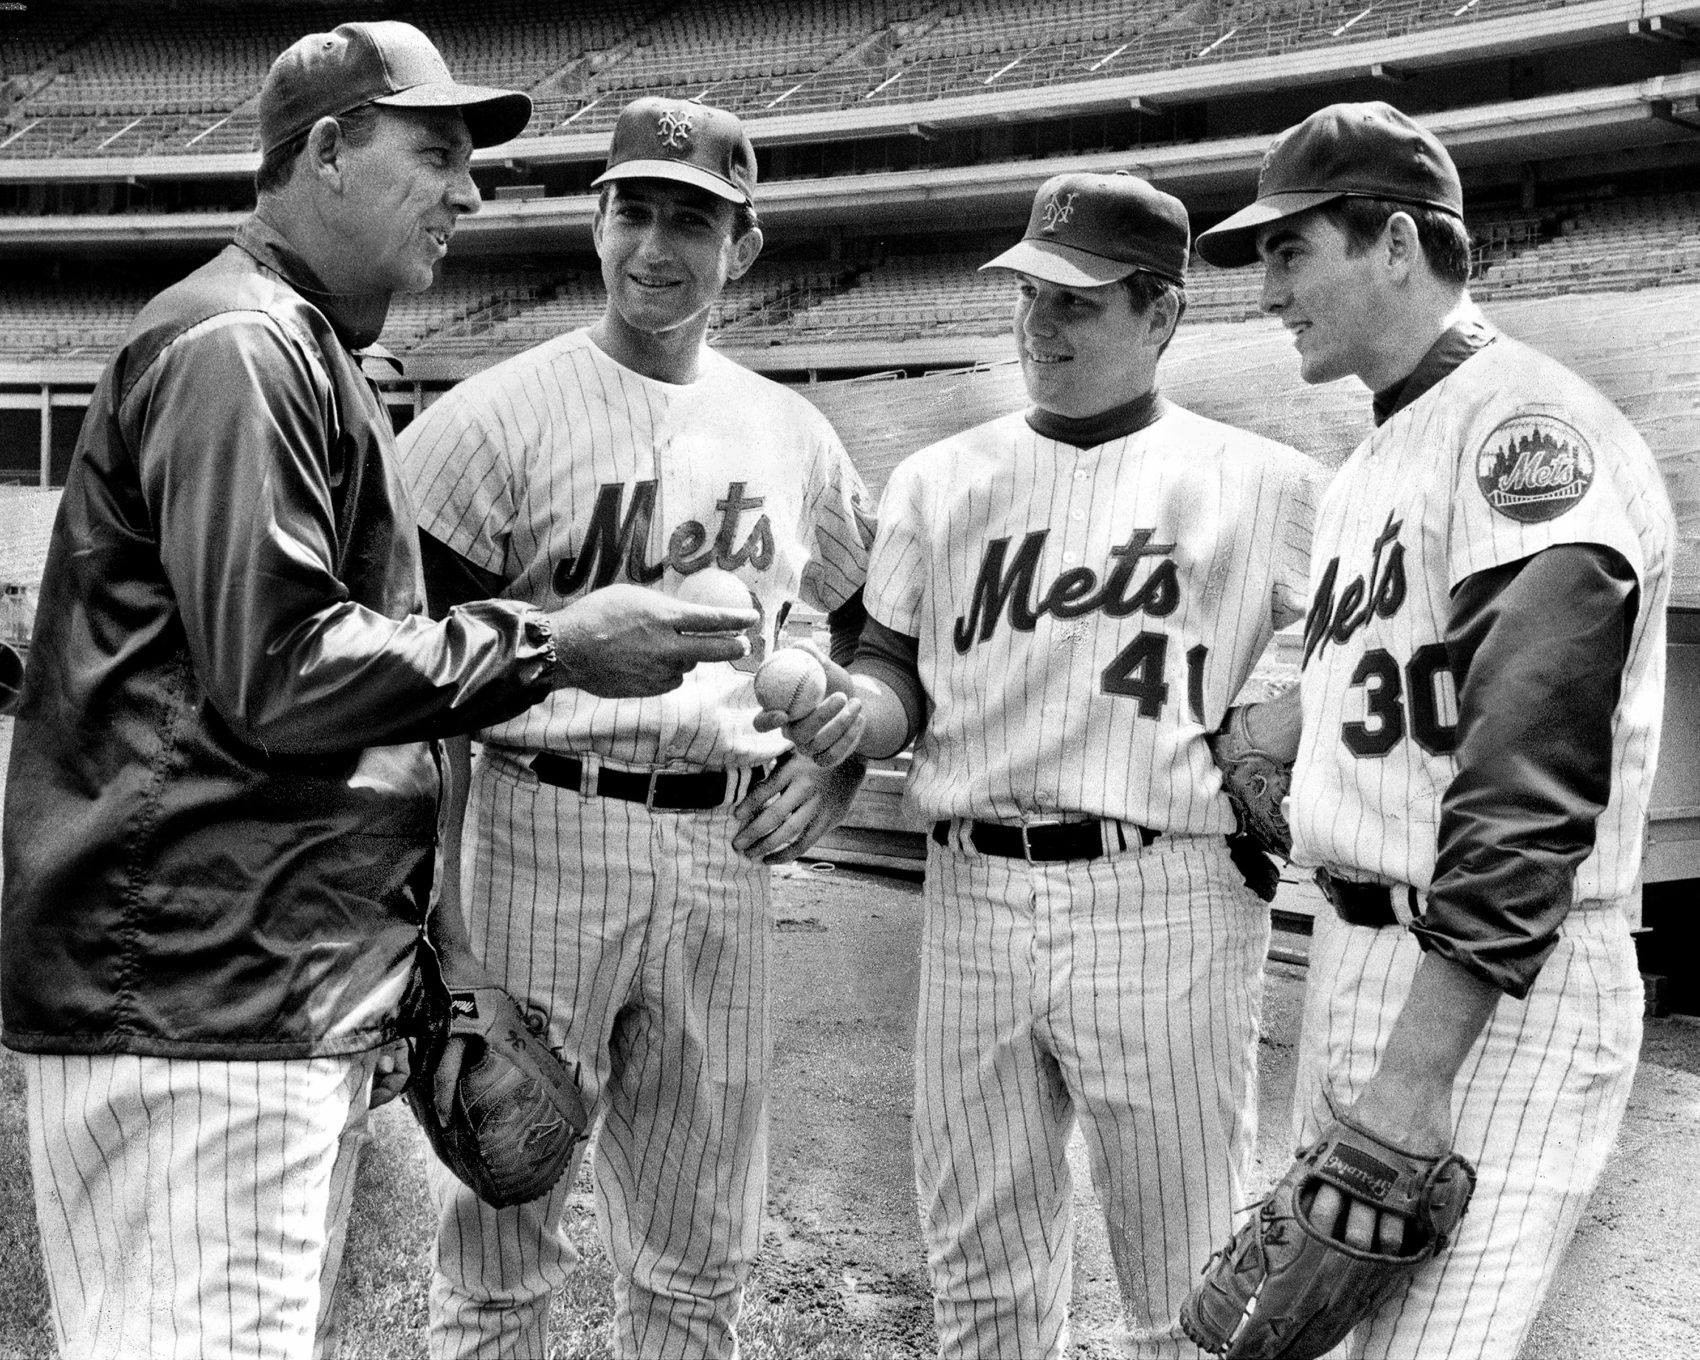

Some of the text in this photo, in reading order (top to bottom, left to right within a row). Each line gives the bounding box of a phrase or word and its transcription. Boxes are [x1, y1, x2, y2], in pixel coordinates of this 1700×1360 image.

[1499, 450, 1576, 492] Mets
[552, 479, 775, 597] Mets
[953, 528, 1180, 655] Mets
[1100, 631, 1208, 722] 41
[1341, 642, 1463, 759] 30
